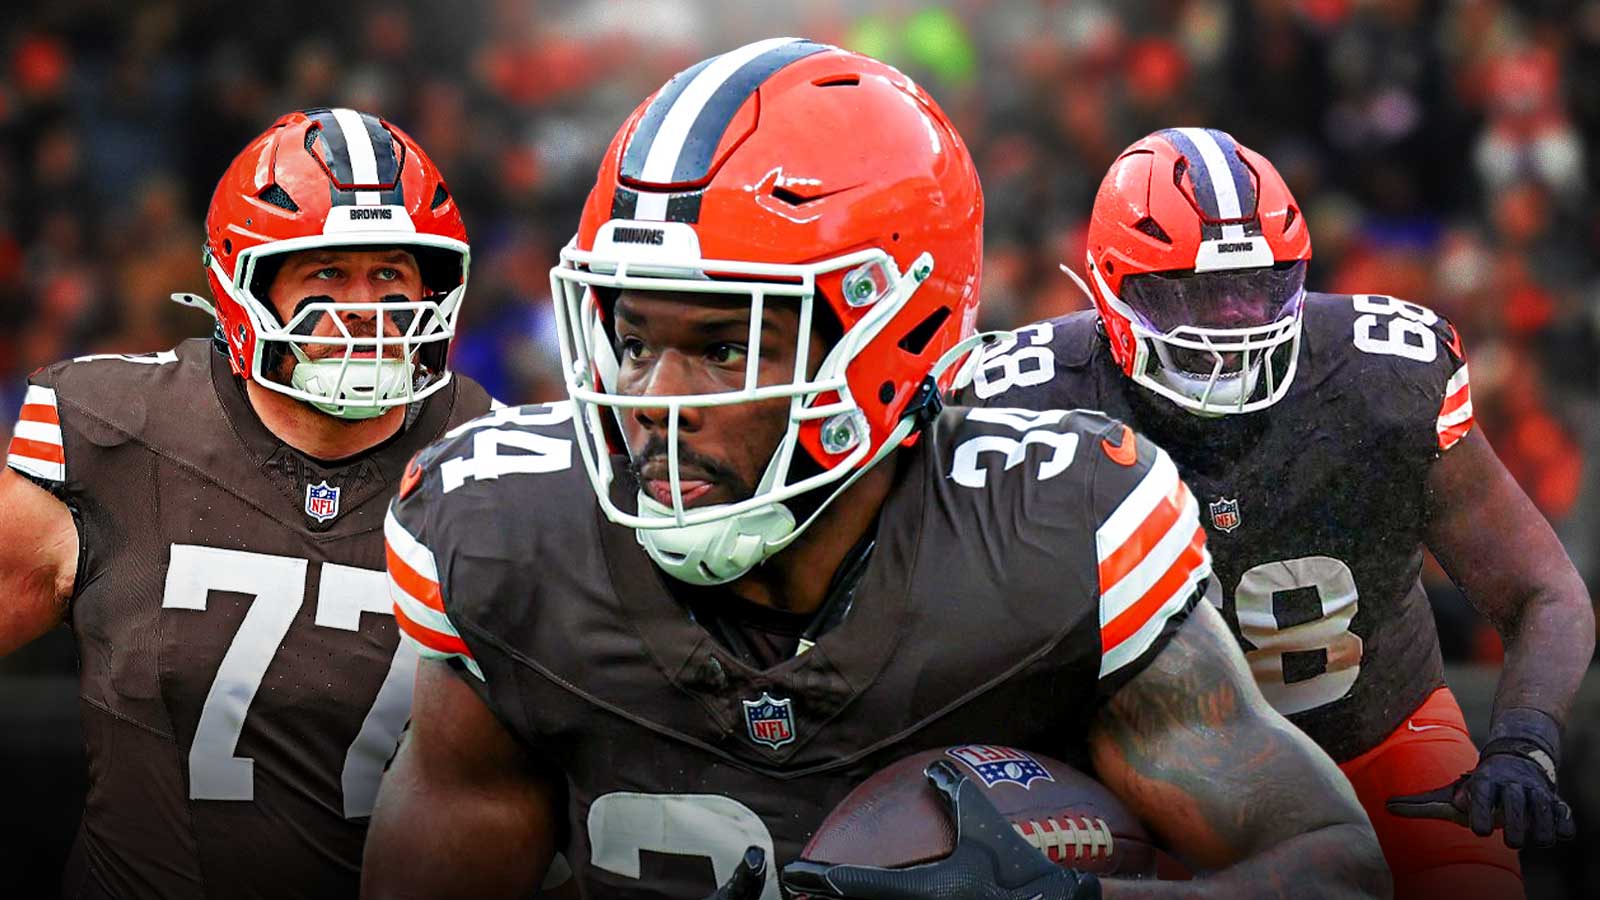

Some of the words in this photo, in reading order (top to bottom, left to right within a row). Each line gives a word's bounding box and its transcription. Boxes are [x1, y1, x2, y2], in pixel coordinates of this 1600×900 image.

[349, 208, 392, 220] BROWNS
[612, 227, 665, 246] BROWNS
[1217, 242, 1253, 253] BROWNS
[1352, 294, 1438, 363] 68
[310, 498, 333, 515] NFL
[1215, 513, 1237, 528] NFL
[1204, 555, 1364, 716] 8
[162, 543, 412, 819] 77
[754, 720, 790, 741] NFL
[955, 744, 1028, 764] NFL
